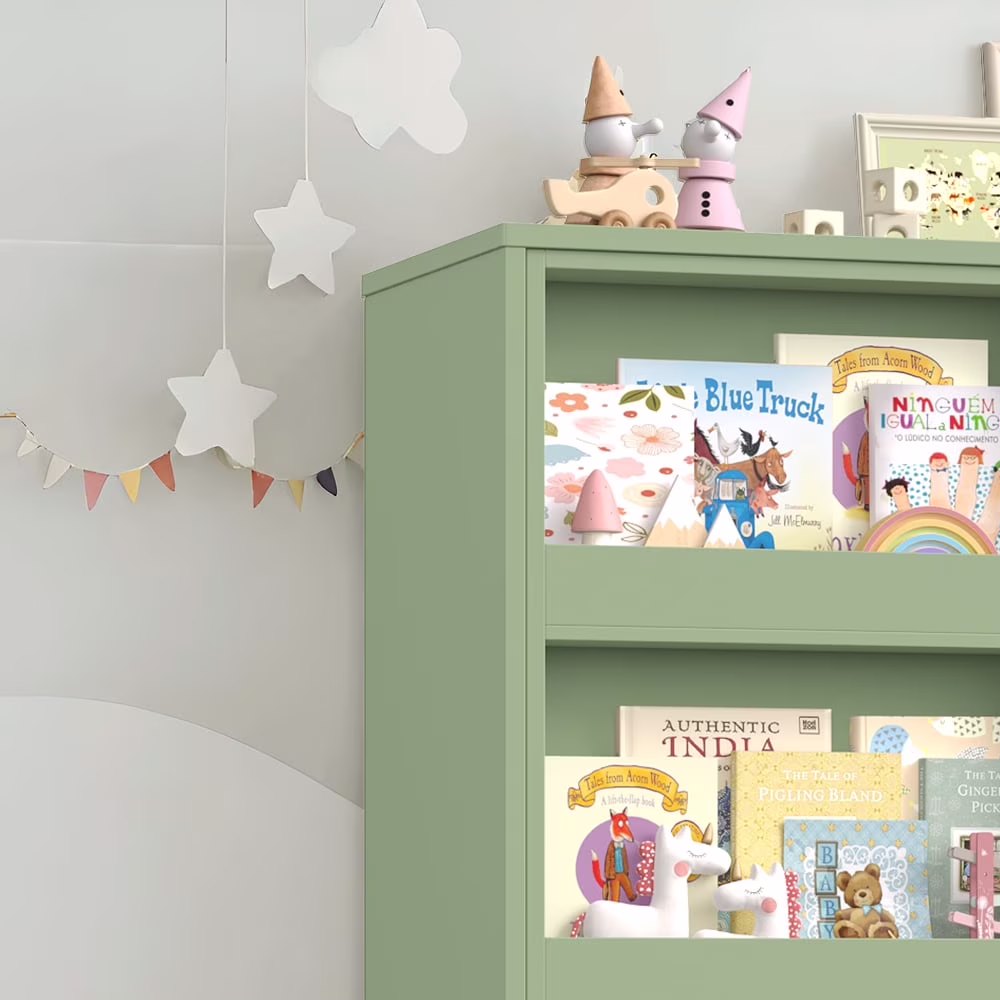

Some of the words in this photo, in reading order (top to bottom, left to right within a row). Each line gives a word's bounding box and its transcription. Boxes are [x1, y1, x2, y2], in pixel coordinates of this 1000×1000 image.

[834, 358, 857, 375] Tales
[859, 353, 880, 367] from
[882, 352, 908, 368] Acorn
[910, 354, 935, 379] Wood
[705, 378, 753, 412] Blue
[756, 380, 825, 425] Truck
[880, 413, 937, 431] IGUAL
[905, 434, 930, 442] LÚDICO
[945, 435, 998, 443] CONHECIMENTO
[662, 719, 780, 734] AUTHENTIC
[661, 735, 775, 758] INDIA
[584, 776, 604, 791] Tales
[606, 771, 624, 784] from
[626, 769, 648, 785] Acorn
[650, 772, 672, 793] Wood
[784, 770, 808, 781] THE
[811, 770, 839, 781] TALE
[843, 772, 857, 781] OF
[964, 770, 985, 780] THE
[601, 796, 607, 806] A
[641, 797, 655, 808] book
[759, 787, 824, 802] PIGLING
[829, 787, 883, 803] BLAND
